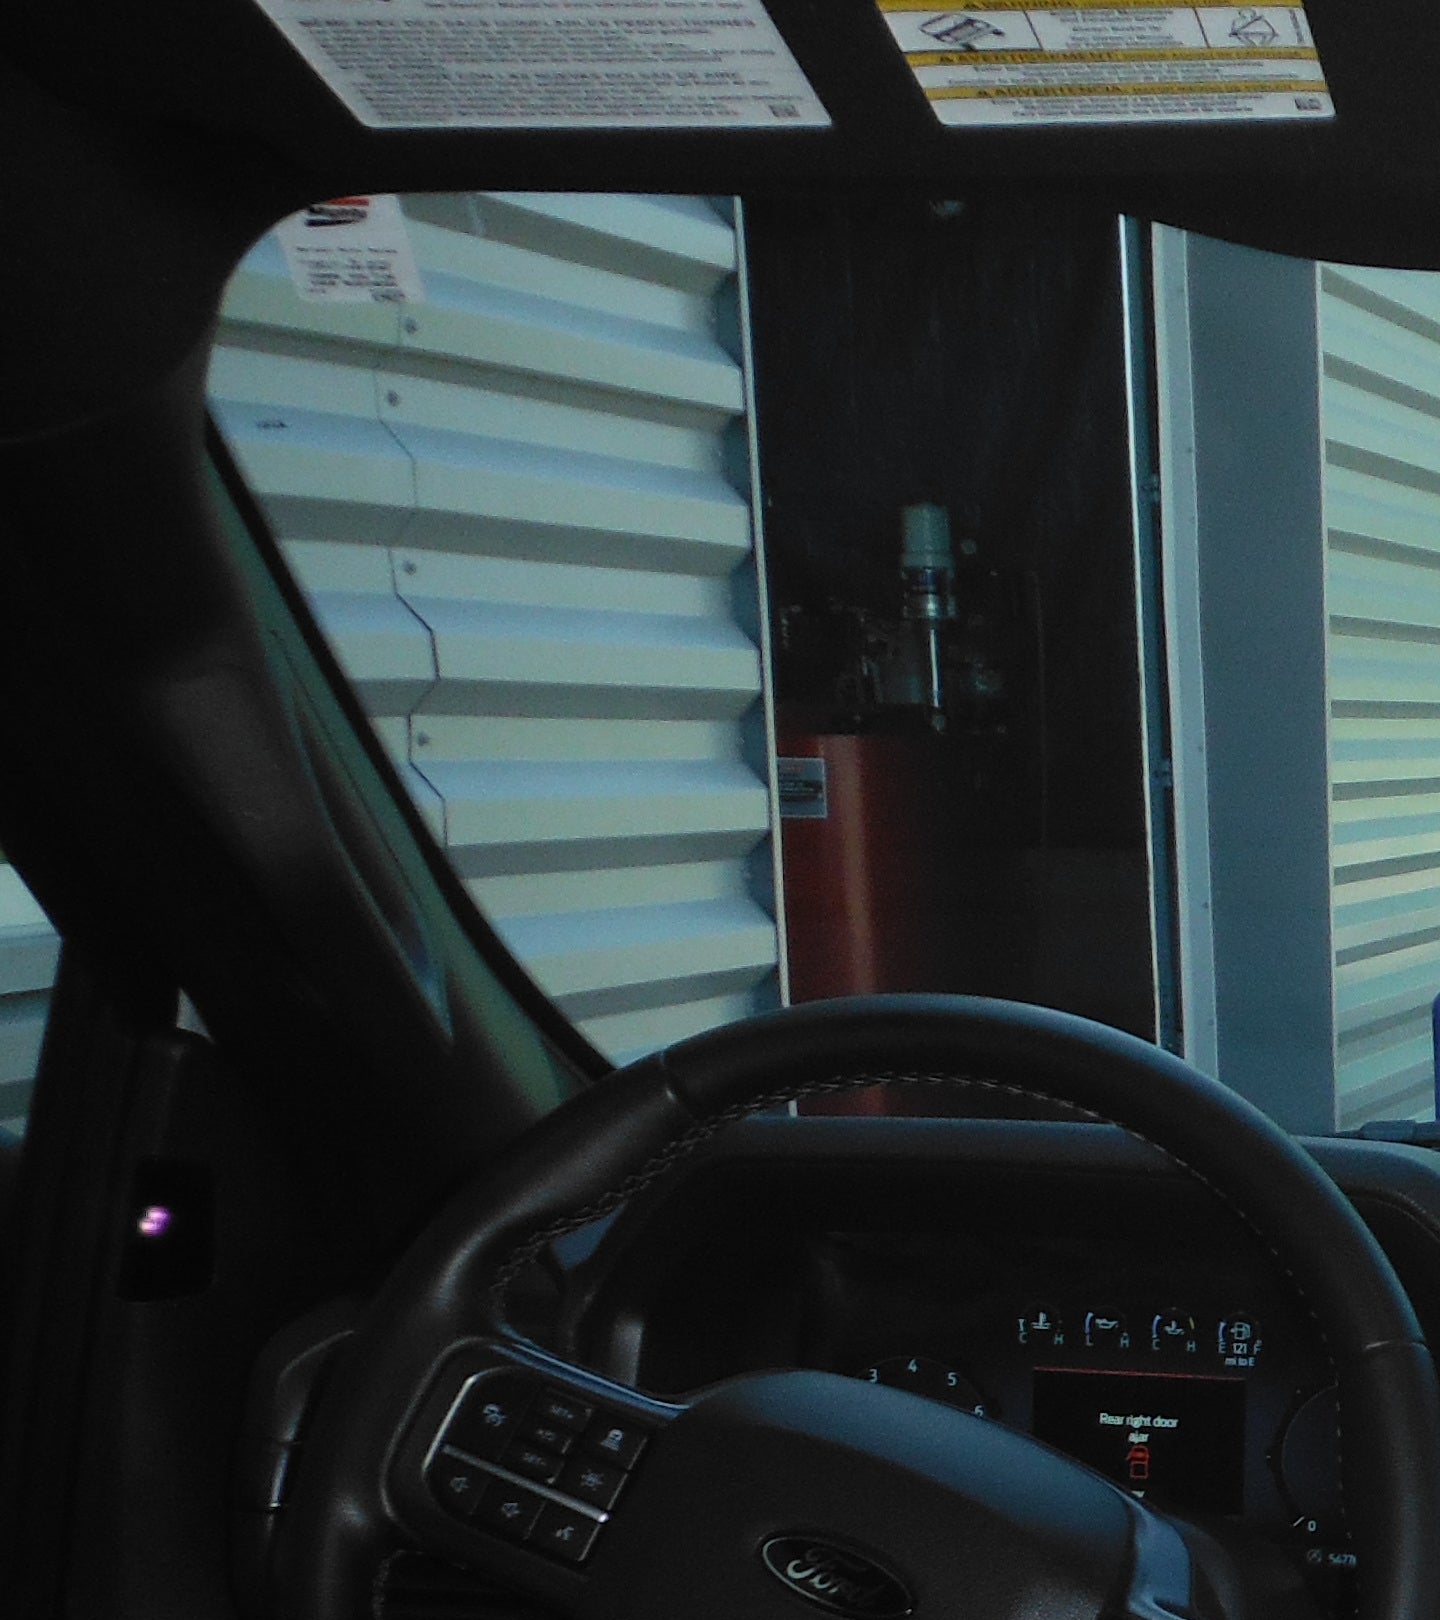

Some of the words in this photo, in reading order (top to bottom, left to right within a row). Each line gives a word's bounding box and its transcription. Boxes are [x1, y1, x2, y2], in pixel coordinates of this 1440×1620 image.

[907, 1358, 918, 1373] 4
[868, 1368, 878, 1383] 3
[947, 1371, 958, 1386] 5
[974, 1405, 984, 1418] 6
[1099, 1412, 1124, 1425] Rear
[1126, 1414, 1152, 1428] right
[1153, 1415, 1179, 1428] door
